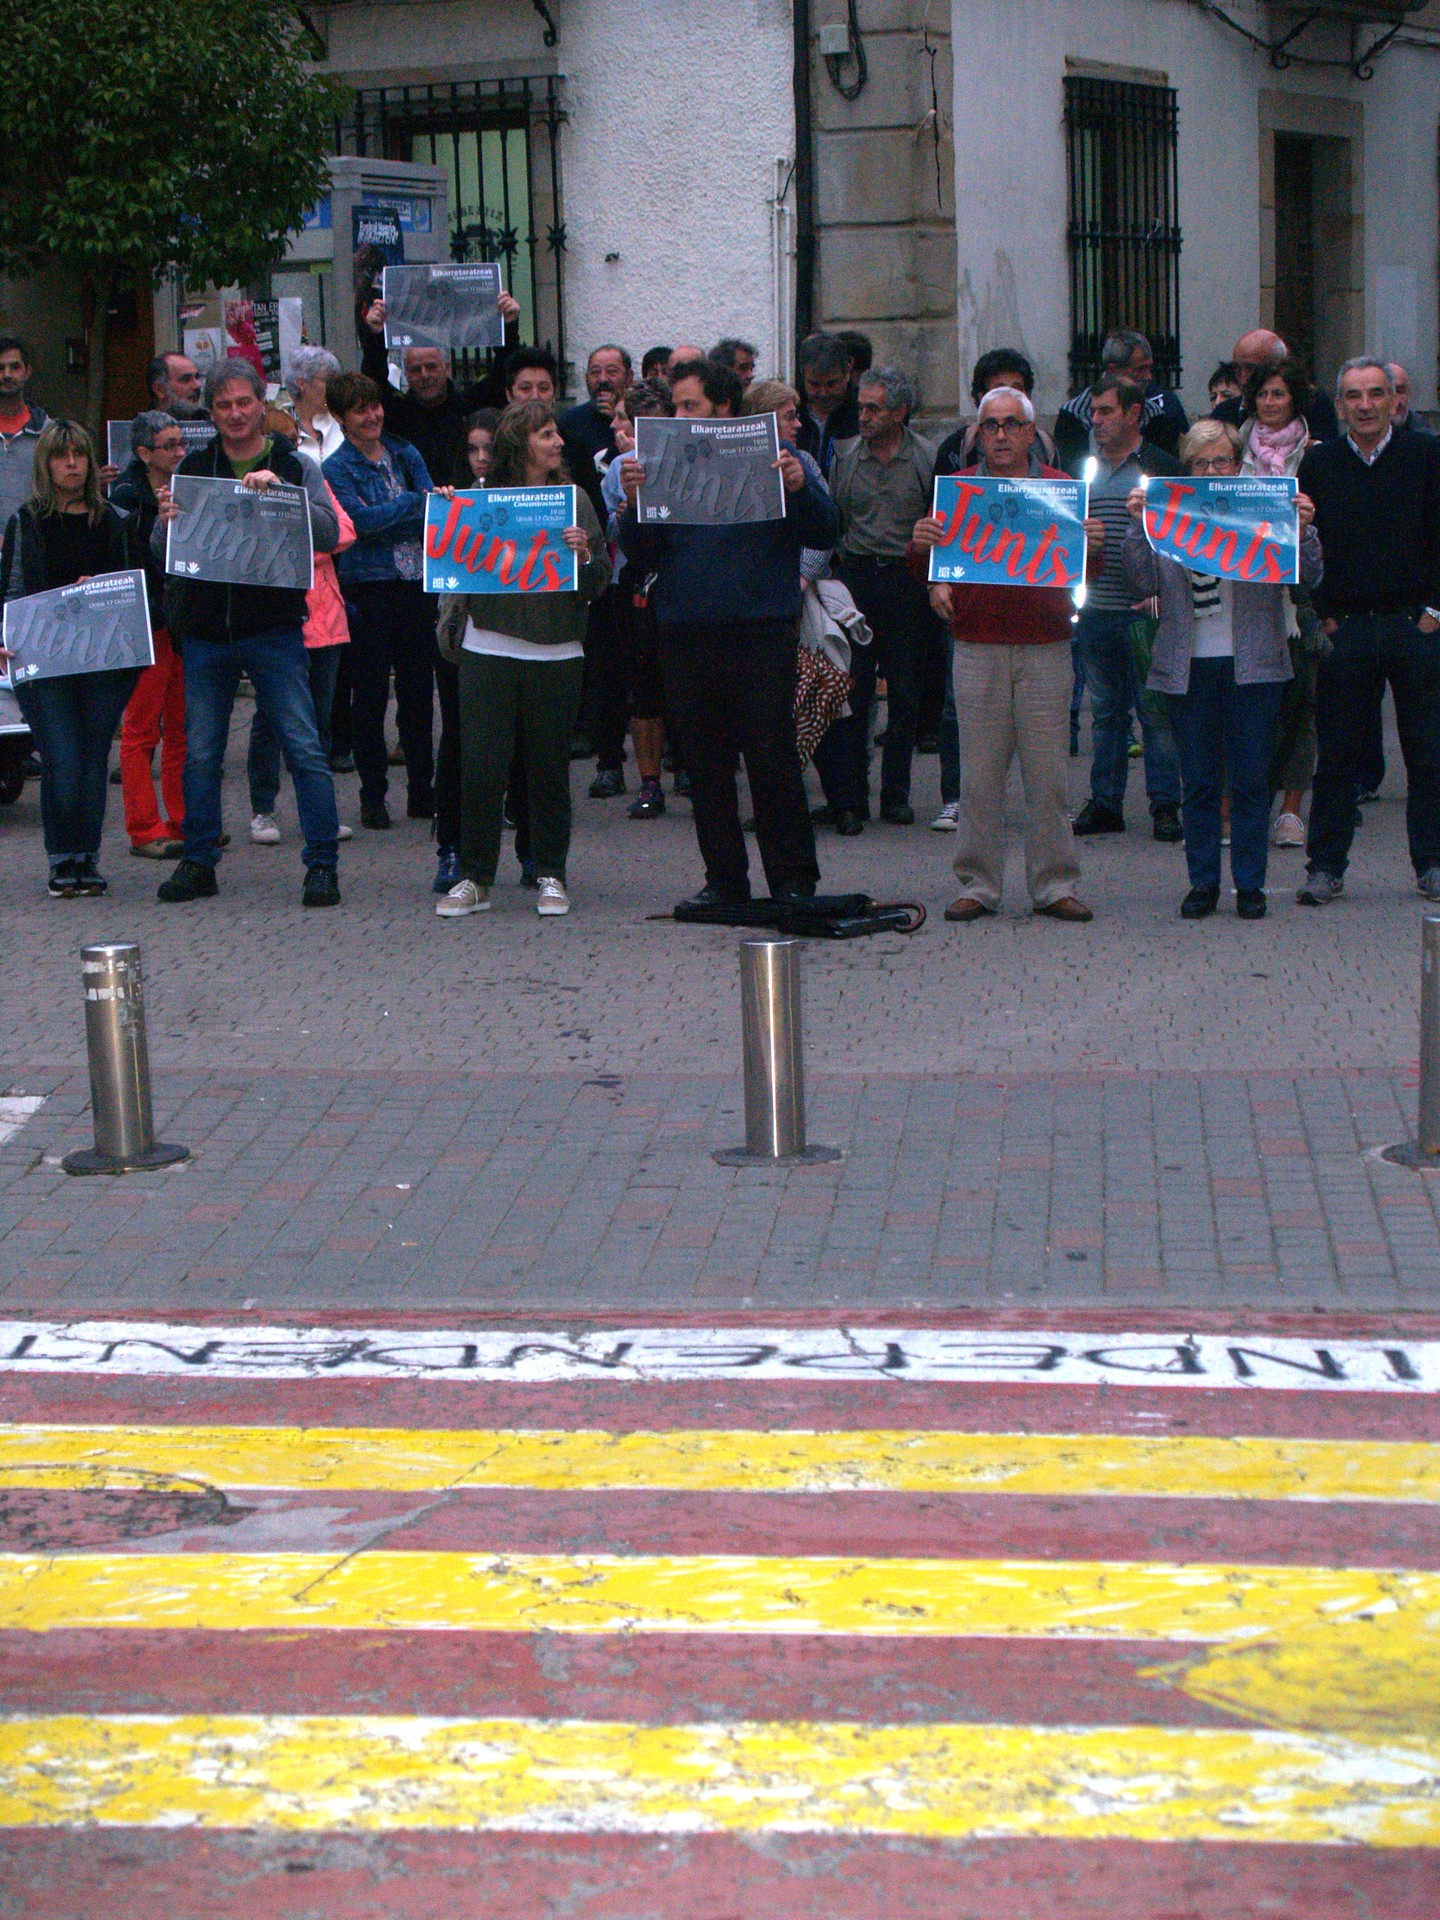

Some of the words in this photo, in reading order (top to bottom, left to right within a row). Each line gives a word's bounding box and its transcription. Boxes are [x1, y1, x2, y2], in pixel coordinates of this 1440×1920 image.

[691, 421, 766, 434] Elkarretaratzeak
[716, 430, 767, 440] Concentraciones
[998, 483, 1077, 494] Elkarretaratzeak
[1208, 481, 1289, 491] Elkarretaratzeak
[488, 491, 566, 503] Elkarretaratzeak
[1234, 490, 1289, 498] Concentraciones
[513, 500, 566, 508] Concentraciones
[935, 480, 1080, 587] Junts
[1145, 481, 1293, 583] Junts
[426, 495, 572, 592] Junts
[61, 576, 135, 597] Elkarretaratzeak
[84, 584, 135, 596] Concentraciones
